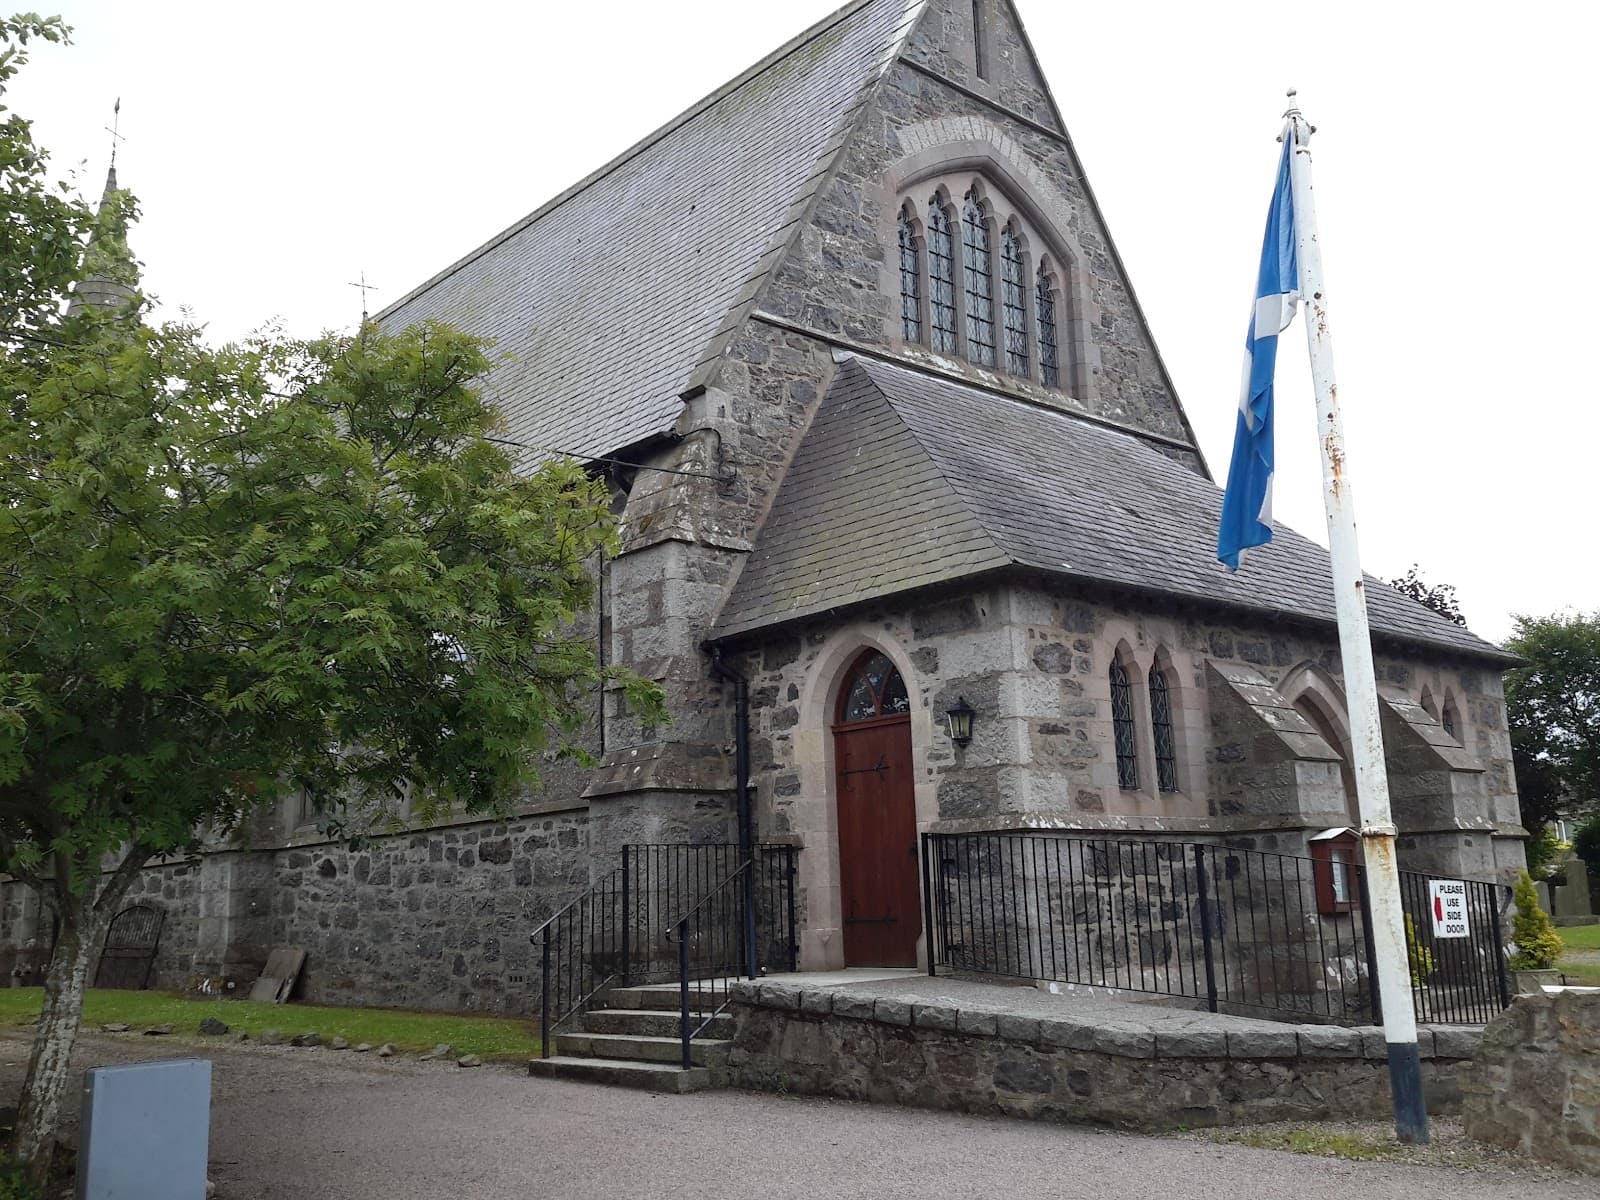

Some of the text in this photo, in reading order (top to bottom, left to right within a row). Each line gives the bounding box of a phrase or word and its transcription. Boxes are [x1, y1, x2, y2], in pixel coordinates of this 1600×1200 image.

[1439, 885, 1464, 894] PLEASE
[1446, 898, 1460, 907] USE
[1447, 911, 1462, 920] SIDE
[1446, 924, 1465, 934] DOOR
